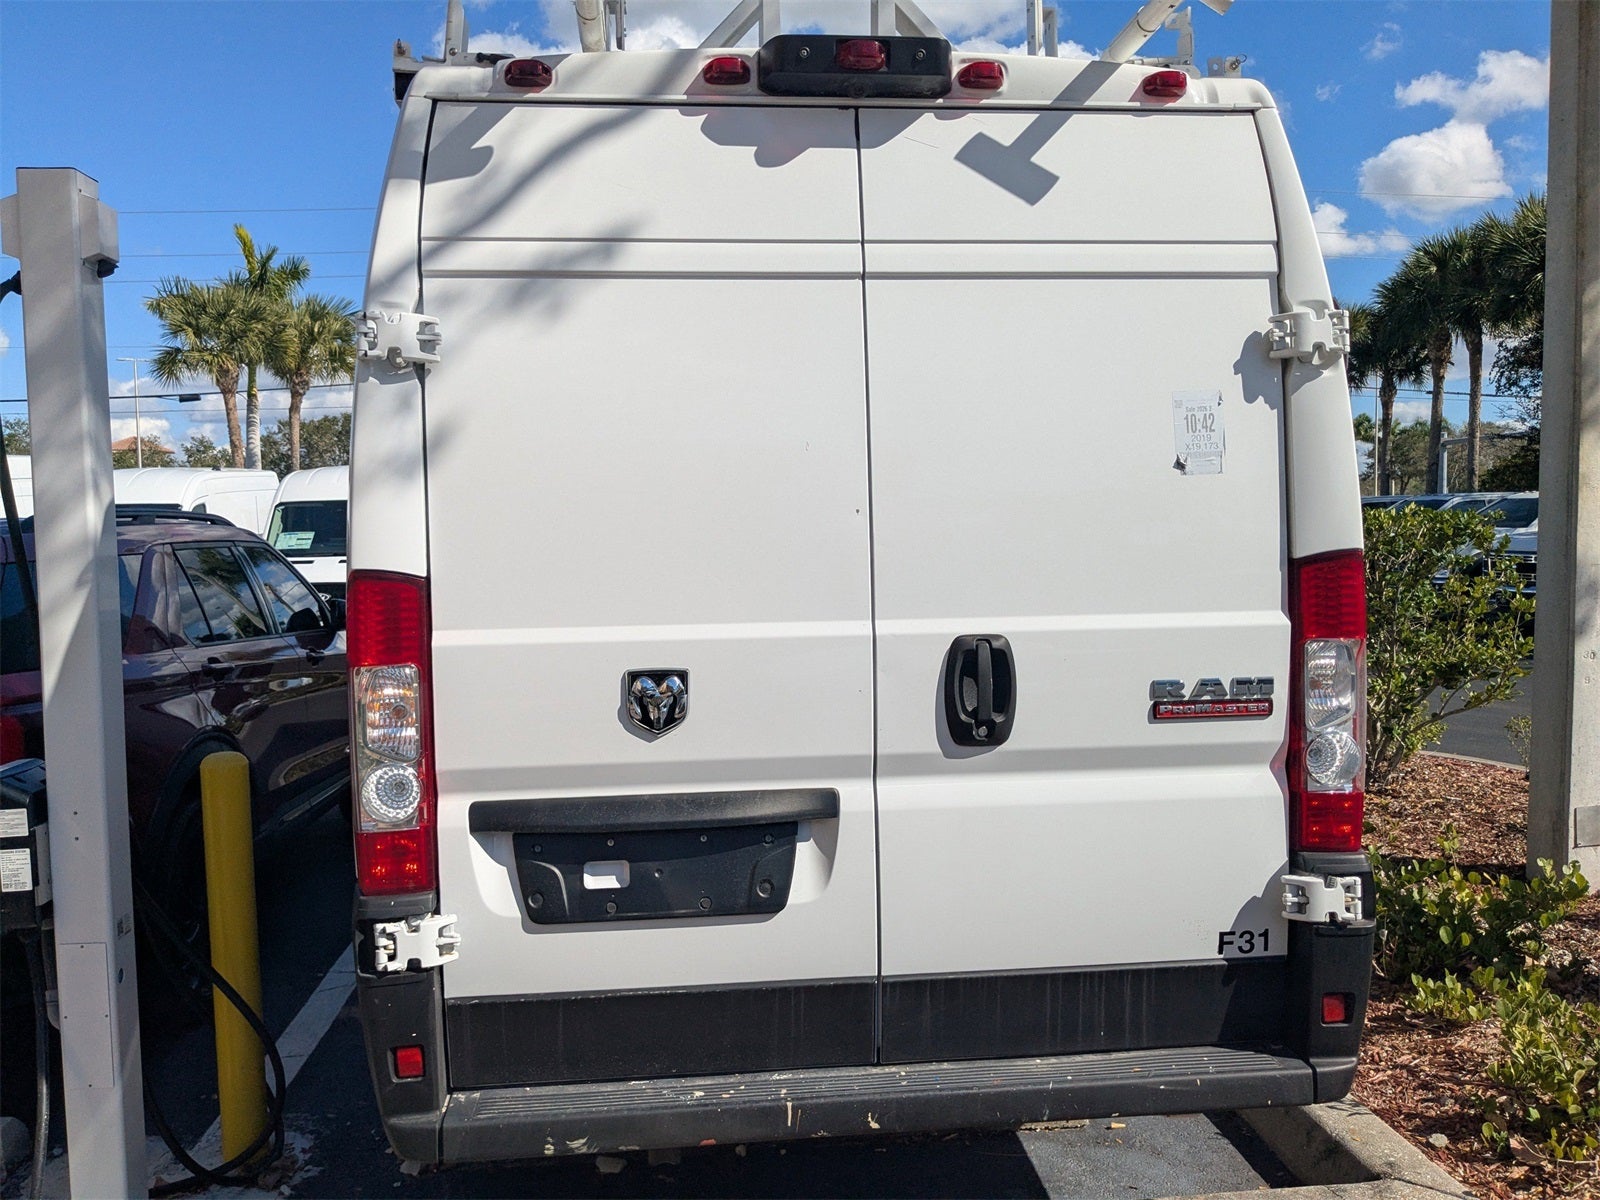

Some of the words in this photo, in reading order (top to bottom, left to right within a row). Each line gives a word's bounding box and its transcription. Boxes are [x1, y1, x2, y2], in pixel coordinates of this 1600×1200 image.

[1184, 413, 1216, 434] 10:42
[1191, 434, 1212, 443] 2019
[1151, 676, 1275, 700] RAM
[1159, 702, 1270, 714] PROMASTER
[1218, 928, 1269, 955] F31
